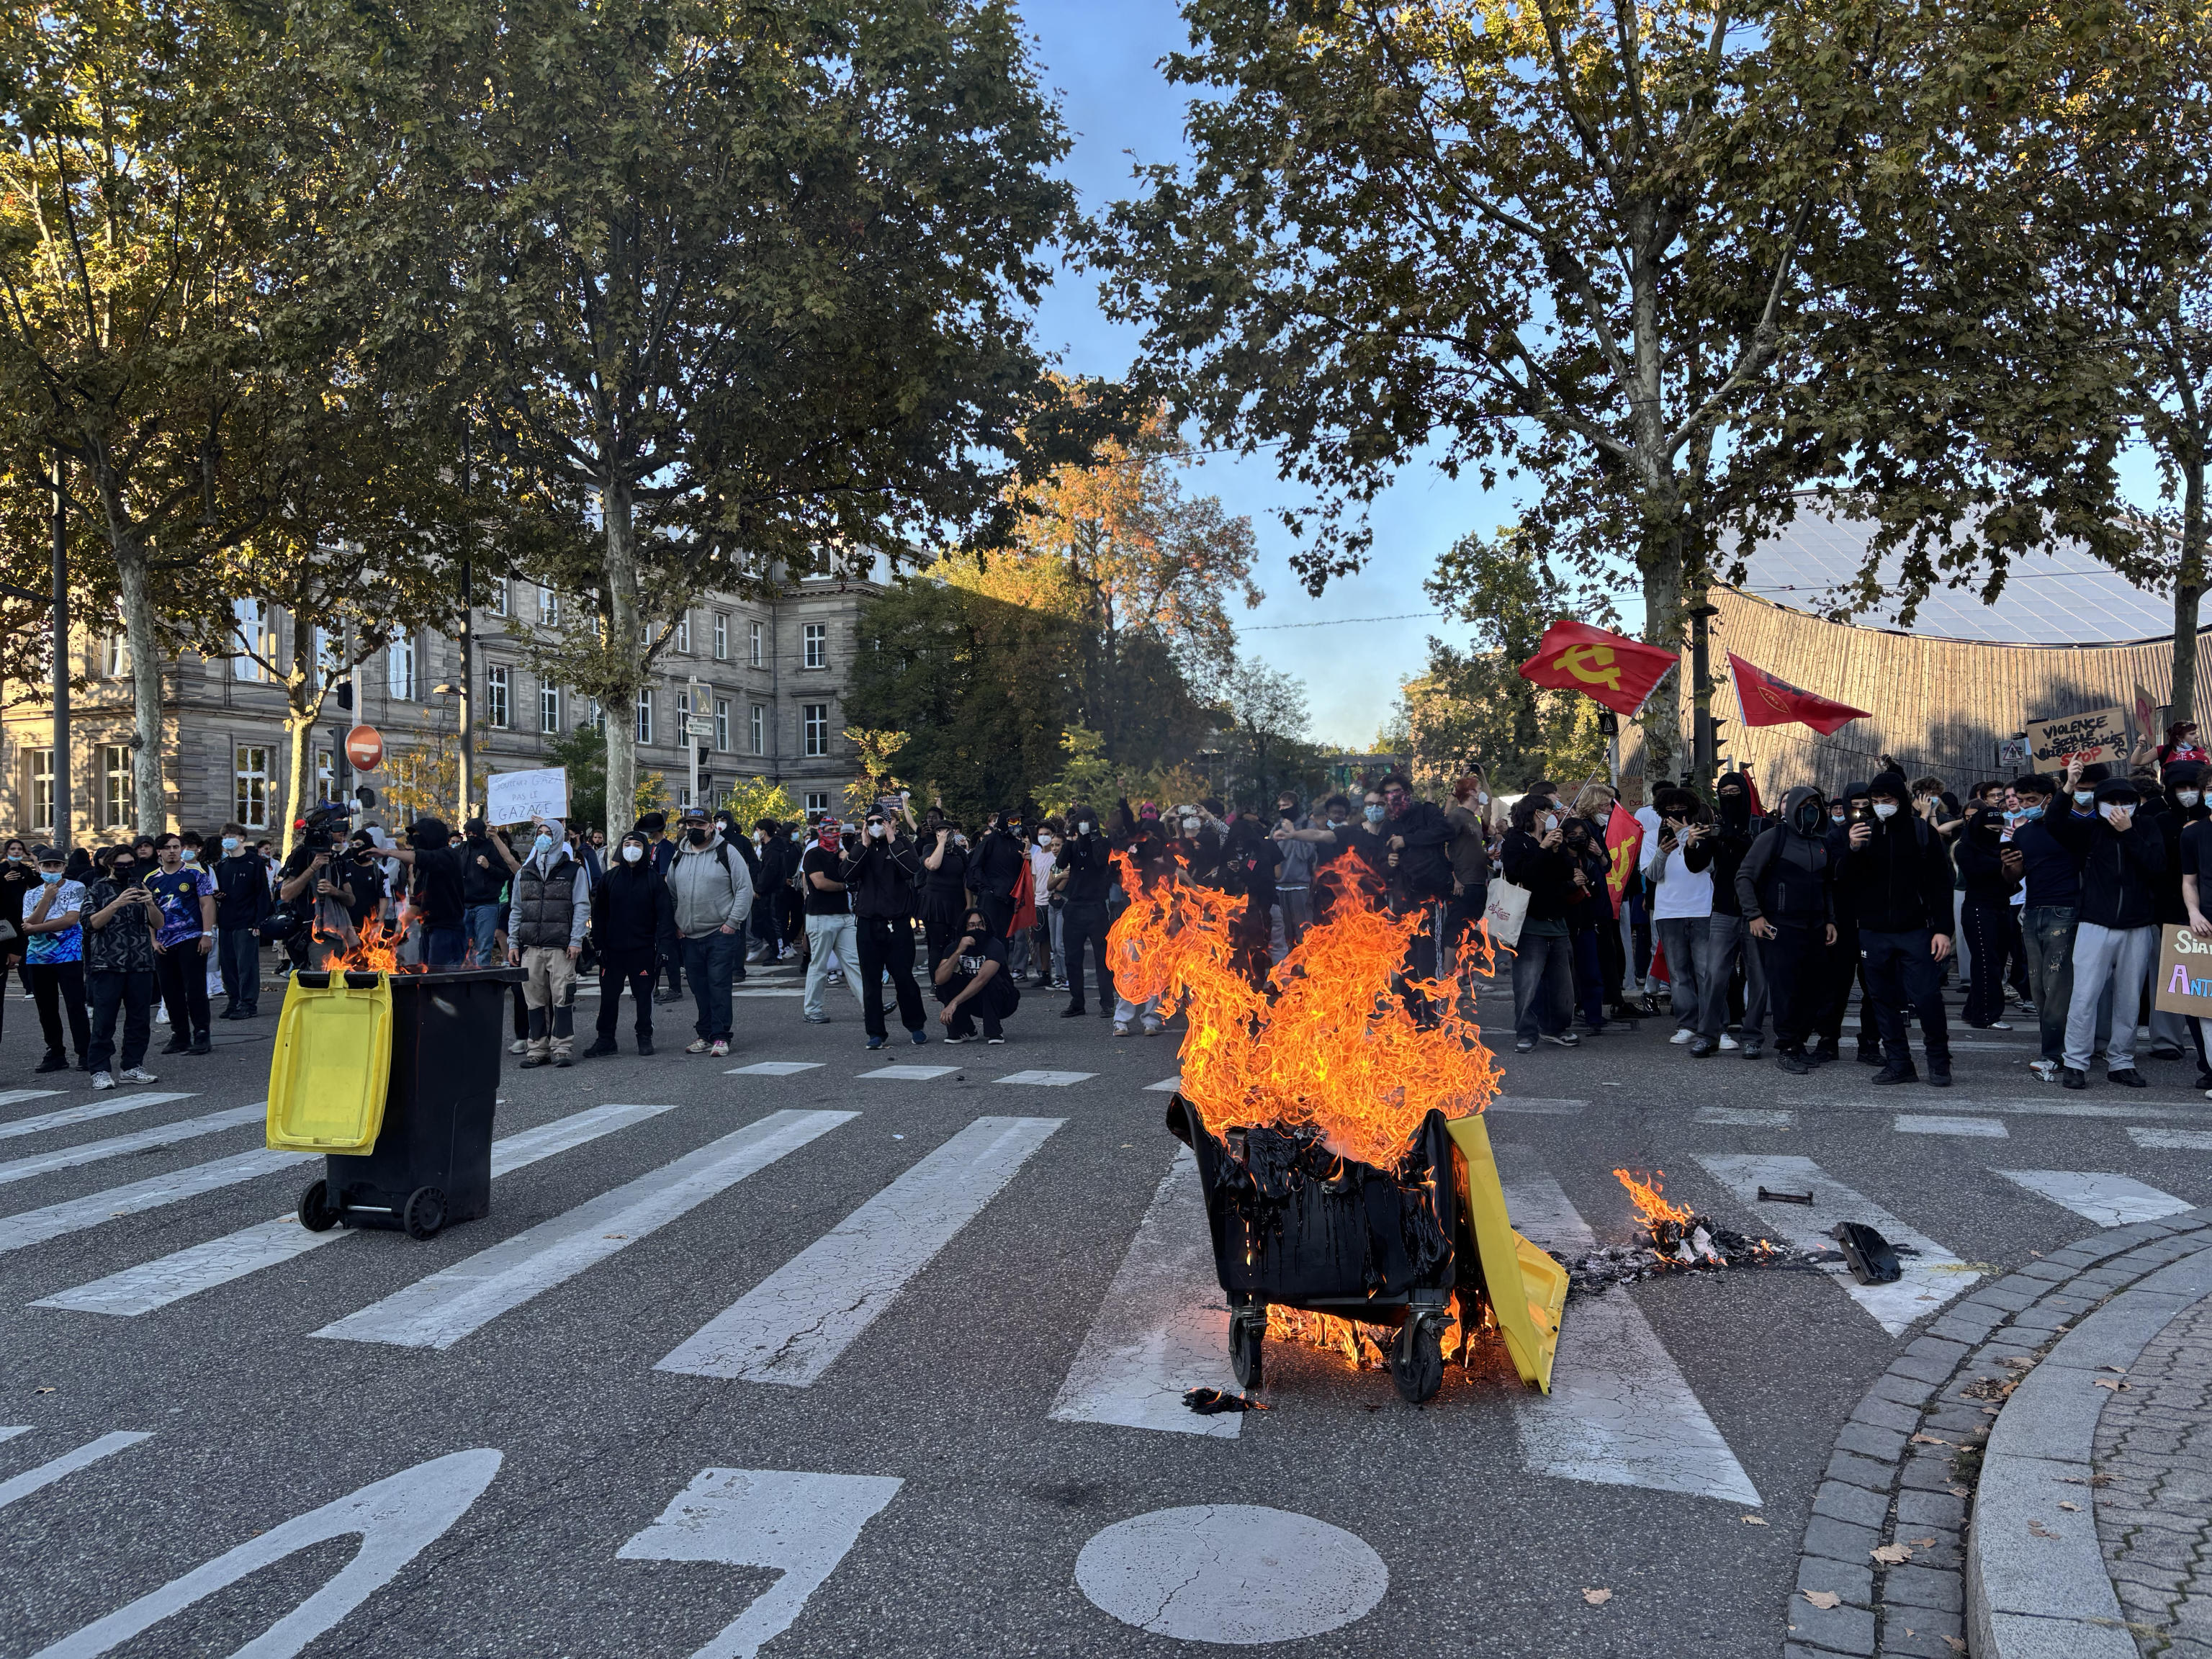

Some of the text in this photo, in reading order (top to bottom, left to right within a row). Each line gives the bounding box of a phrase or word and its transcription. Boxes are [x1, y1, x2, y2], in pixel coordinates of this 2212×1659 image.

[2043, 715, 2108, 739] VIOLENCE
[532, 774, 562, 786] GAZA
[498, 803, 552, 820] GAZAGE
[2174, 930, 2212, 955] SiA
[2167, 963, 2212, 997] ANT
